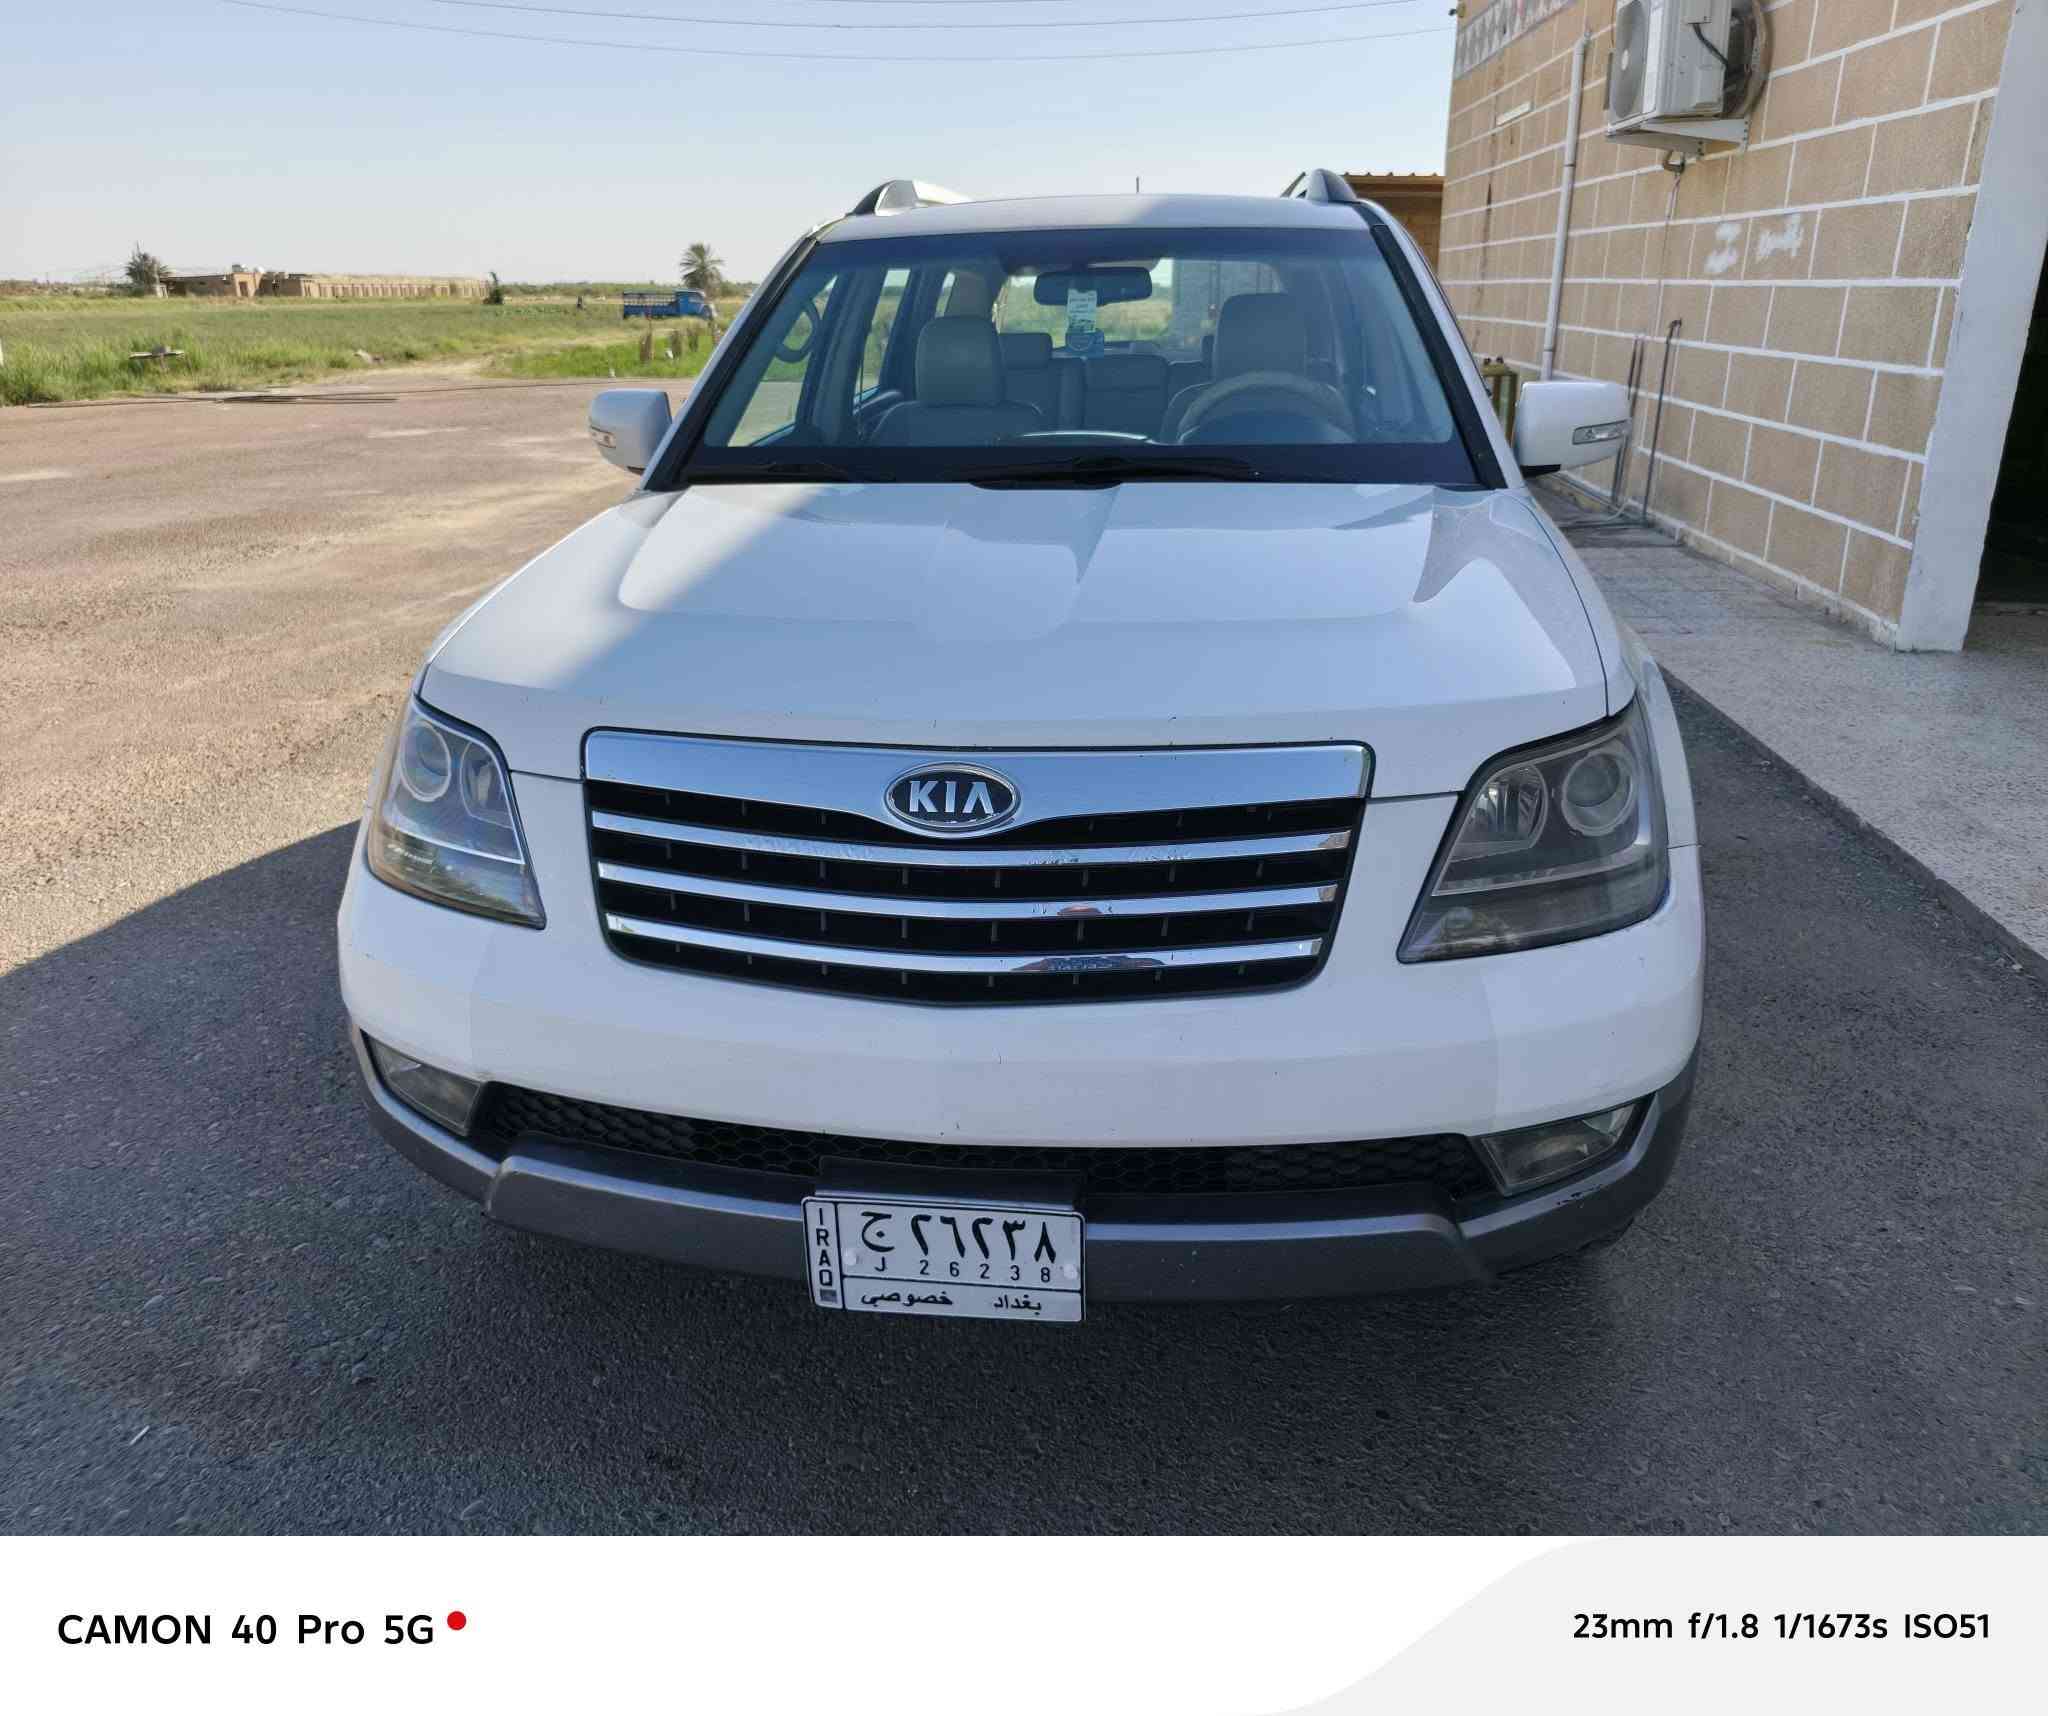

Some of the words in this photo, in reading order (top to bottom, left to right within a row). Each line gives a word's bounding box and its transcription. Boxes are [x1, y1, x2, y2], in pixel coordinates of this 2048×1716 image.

[909, 780, 994, 814] KIA
[815, 1207, 833, 1287] IRAQ
[910, 1213, 1057, 1264] ٢٦٢٣٨
[918, 1259, 1051, 1283] 26238
[993, 1294, 1042, 1316] بغداد
